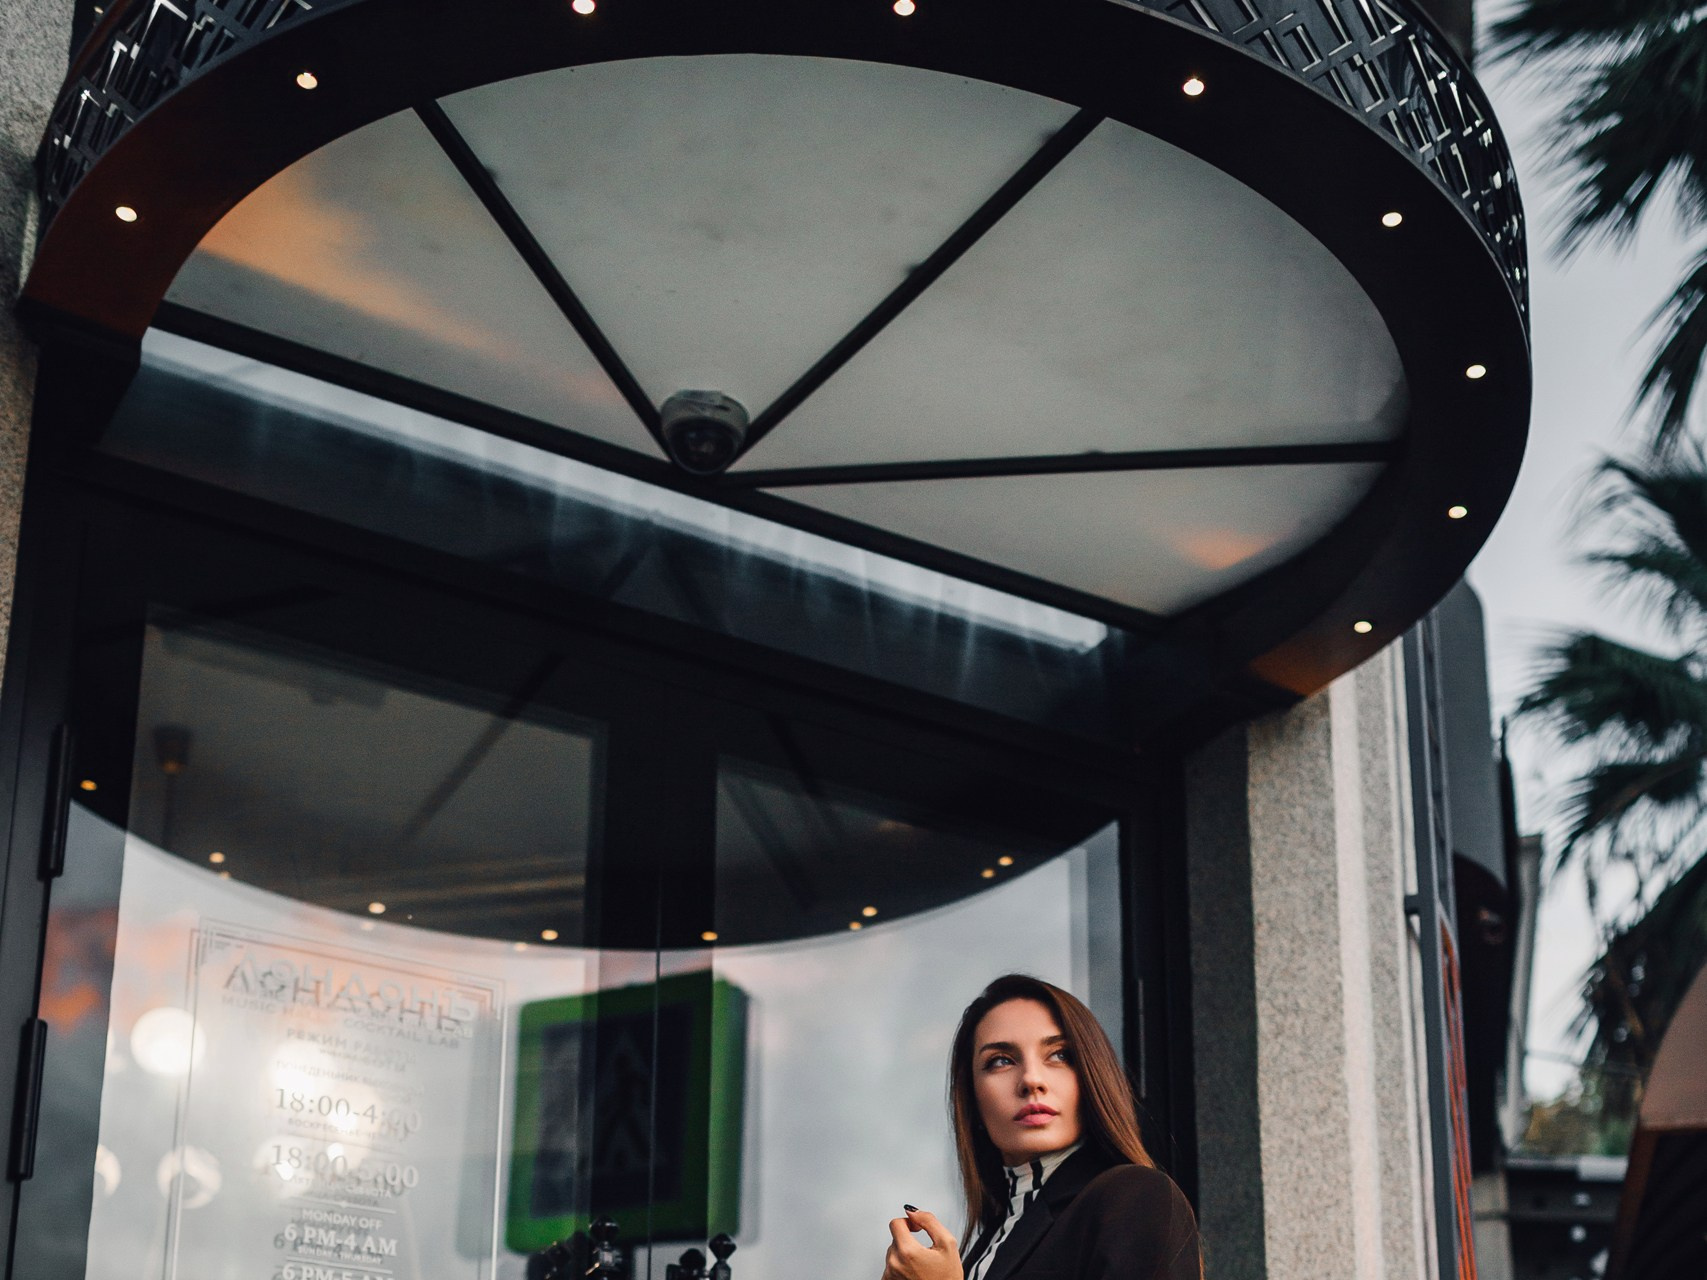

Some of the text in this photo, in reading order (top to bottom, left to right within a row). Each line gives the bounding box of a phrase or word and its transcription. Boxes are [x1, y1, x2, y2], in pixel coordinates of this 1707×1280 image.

[286, 1027, 348, 1051] РЕЖИМ
[302, 1209, 384, 1231] MONDAY OFF
[284, 1223, 298, 1241] 6
[362, 1236, 398, 1257] AM
[282, 1263, 296, 1280] 6
